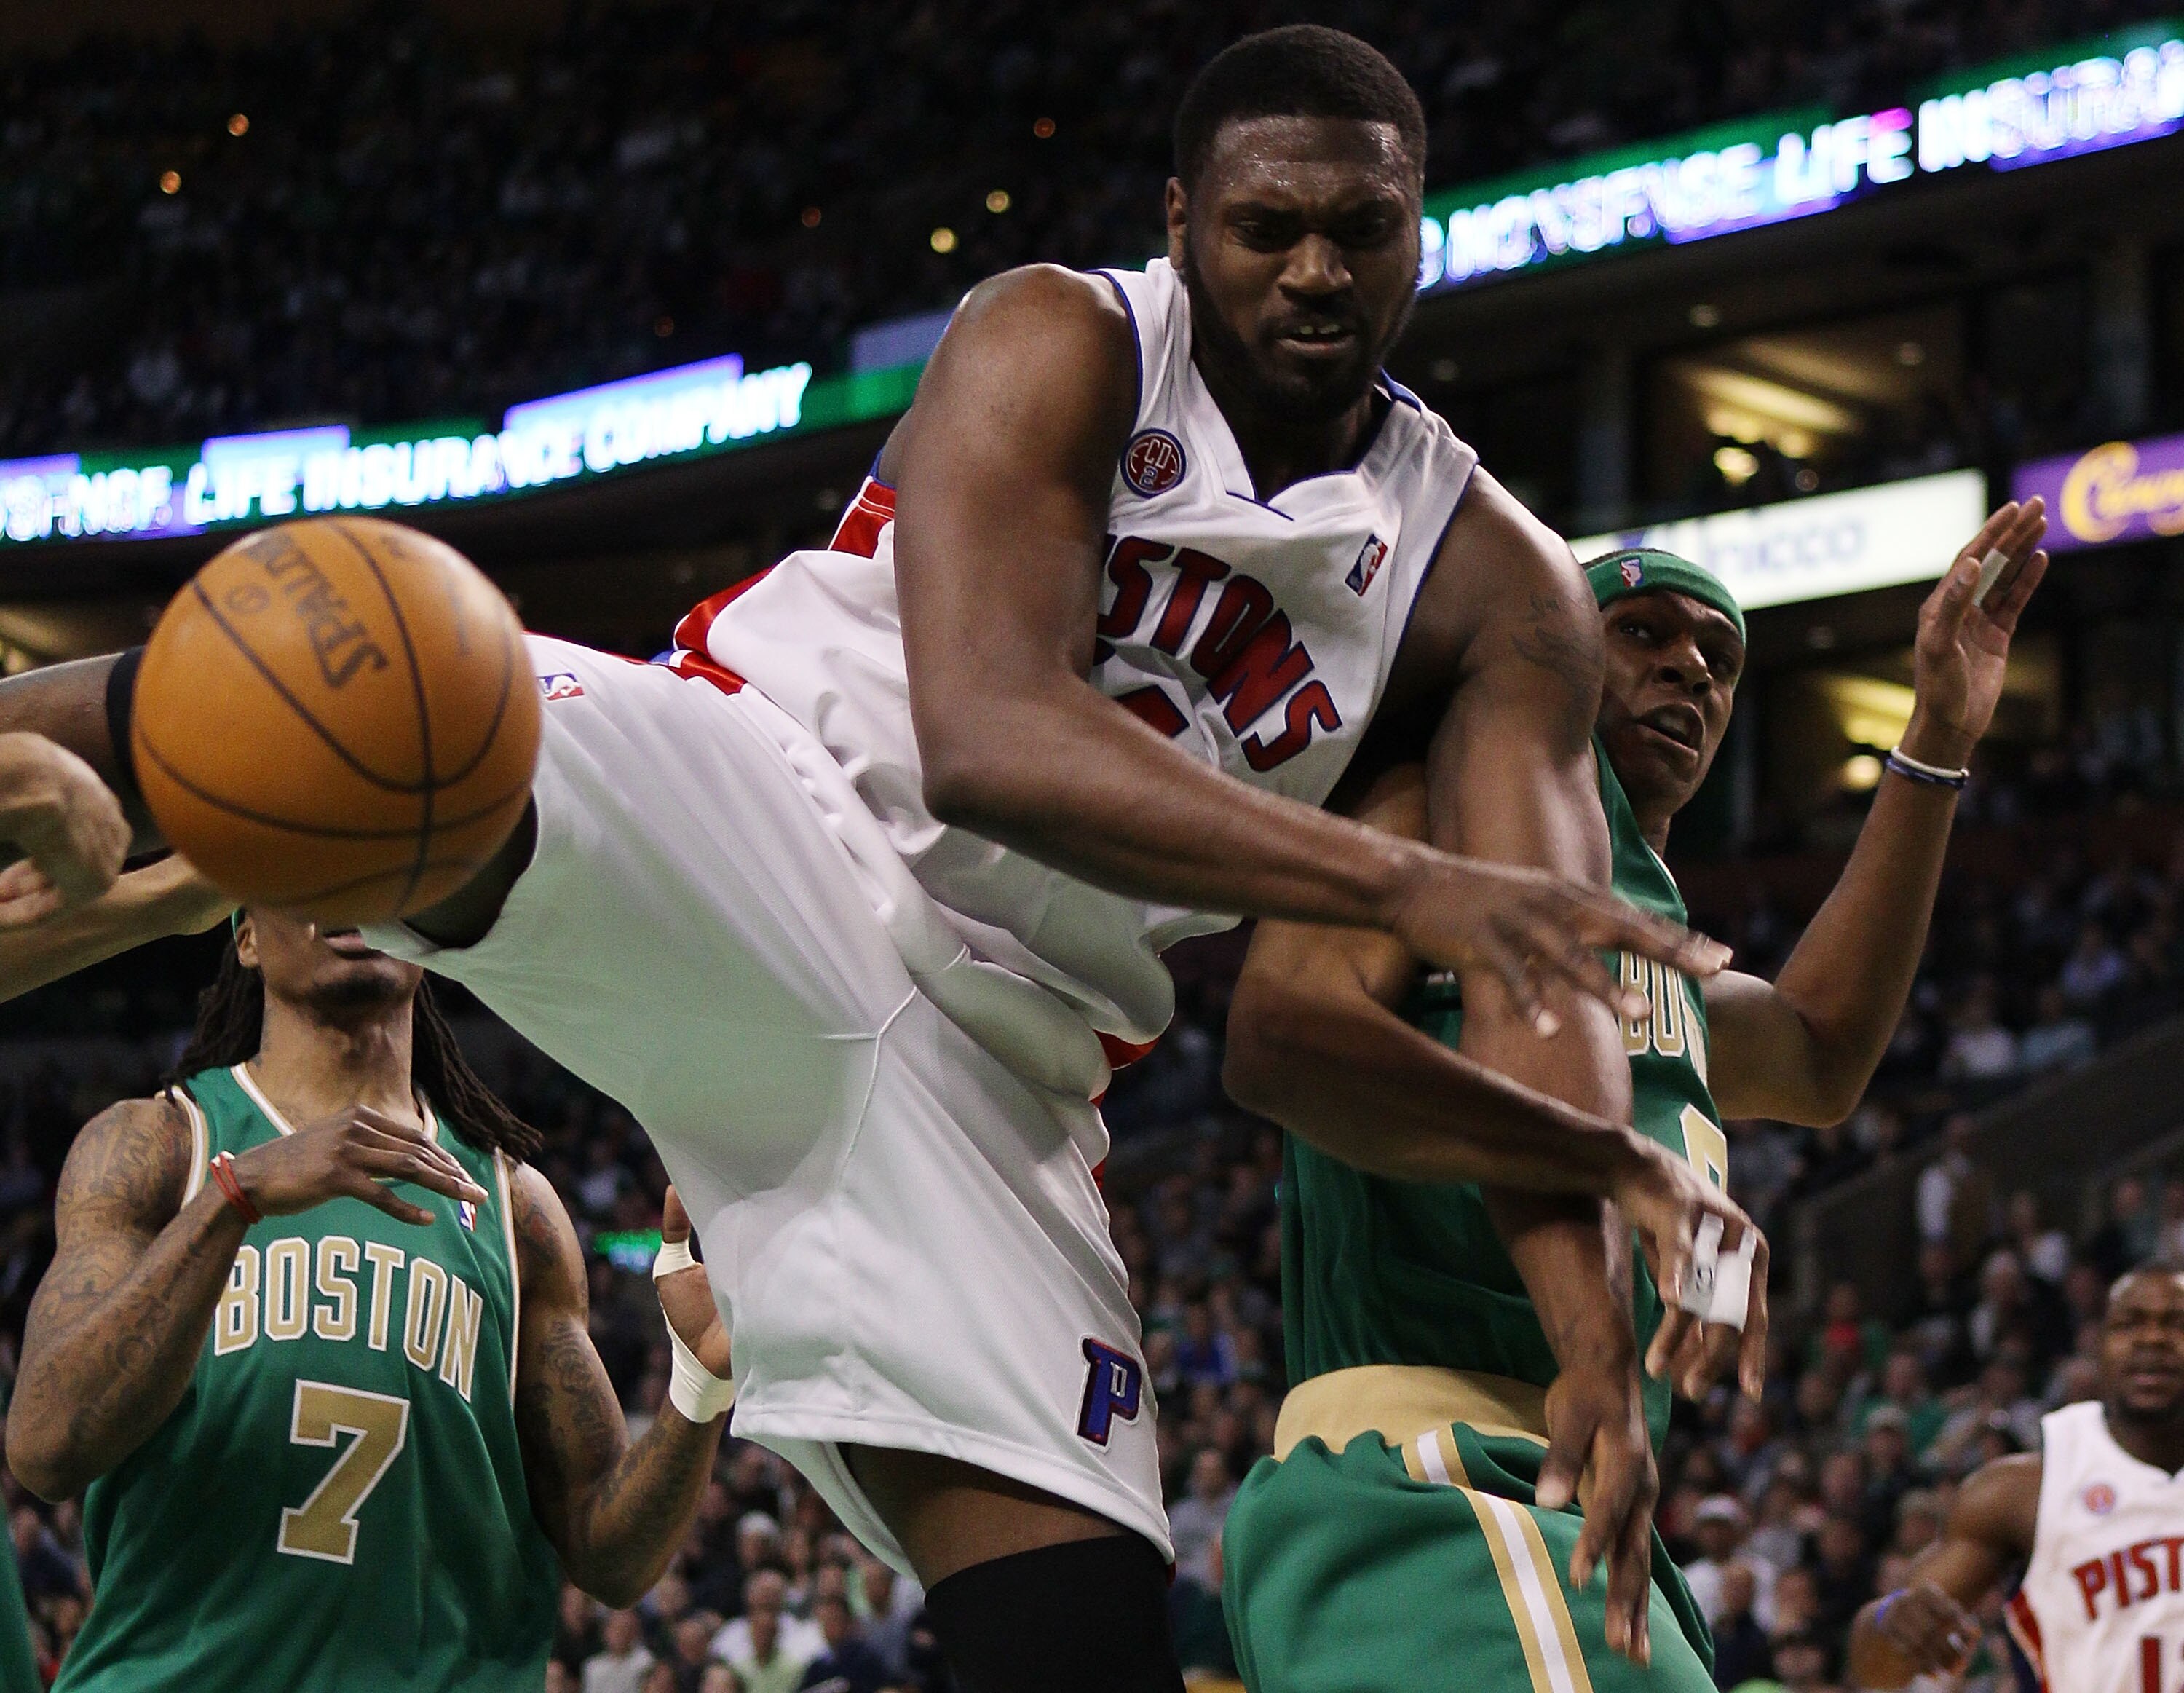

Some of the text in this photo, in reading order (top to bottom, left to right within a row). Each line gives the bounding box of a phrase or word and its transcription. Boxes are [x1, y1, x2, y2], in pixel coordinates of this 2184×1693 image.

[1775, 107, 1914, 203] LIFE
[183, 448, 297, 526] LIFE
[1096, 534, 1379, 772] STONS
[214, 1236, 483, 1404] BOSTON
[1077, 1336, 1142, 1448] P
[277, 1379, 410, 1565] 7
[2140, 1635, 2184, 1693] 1
